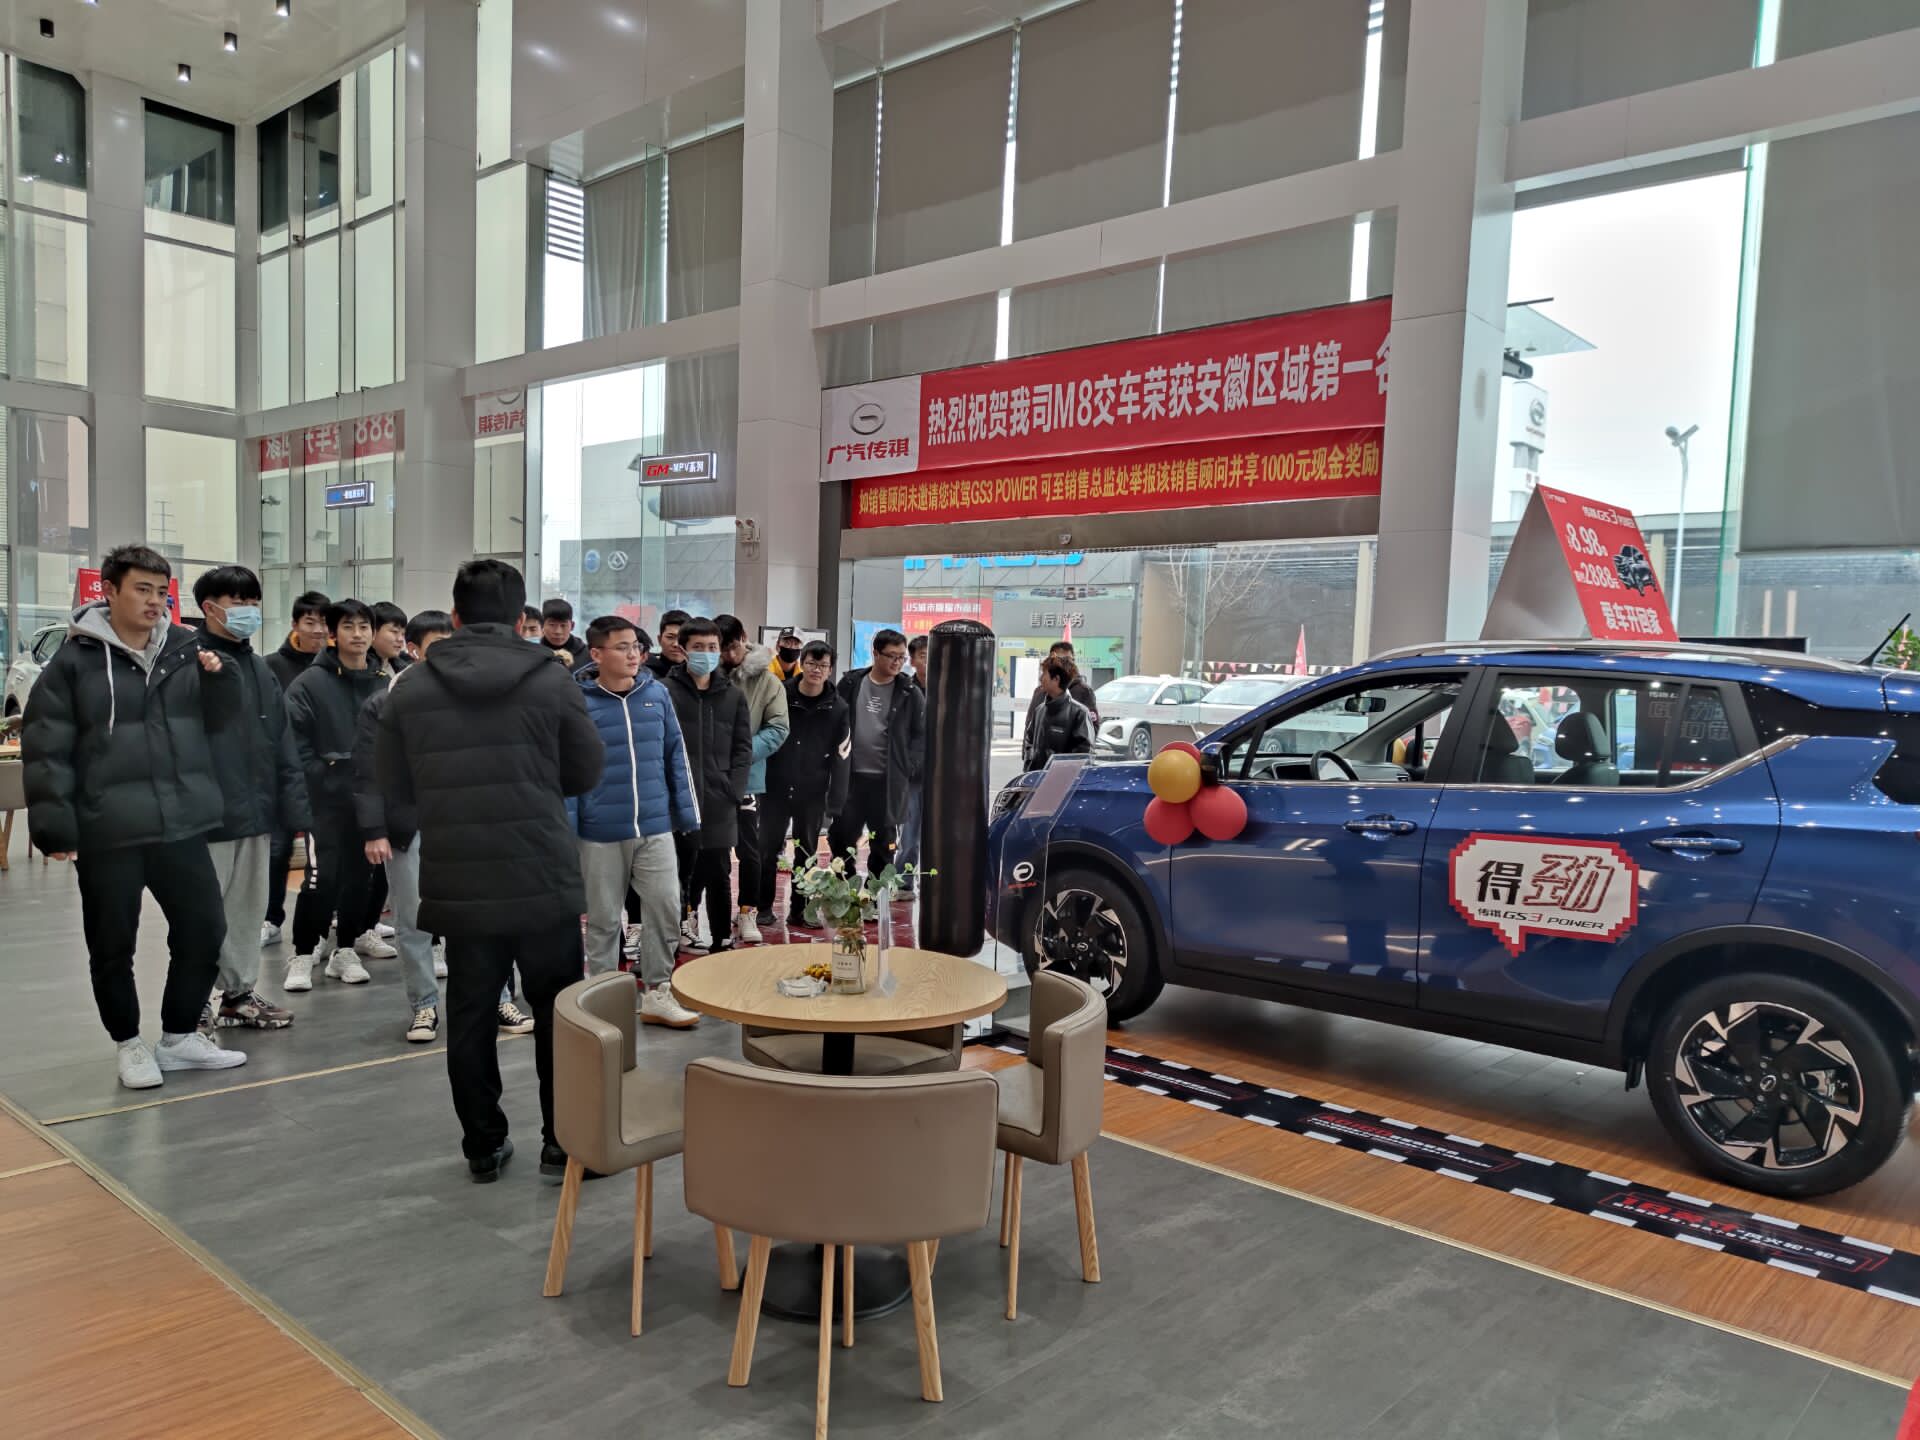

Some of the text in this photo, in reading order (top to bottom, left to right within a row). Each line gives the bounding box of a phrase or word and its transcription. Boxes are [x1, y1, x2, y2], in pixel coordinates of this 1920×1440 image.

[827, 438, 910, 464] 广汽传祺
[995, 475, 1038, 502] POWER
[1030, 611, 1085, 628] 售后服务
[1477, 853, 1615, 914] 得劲
[1547, 916, 1605, 930] POWER
